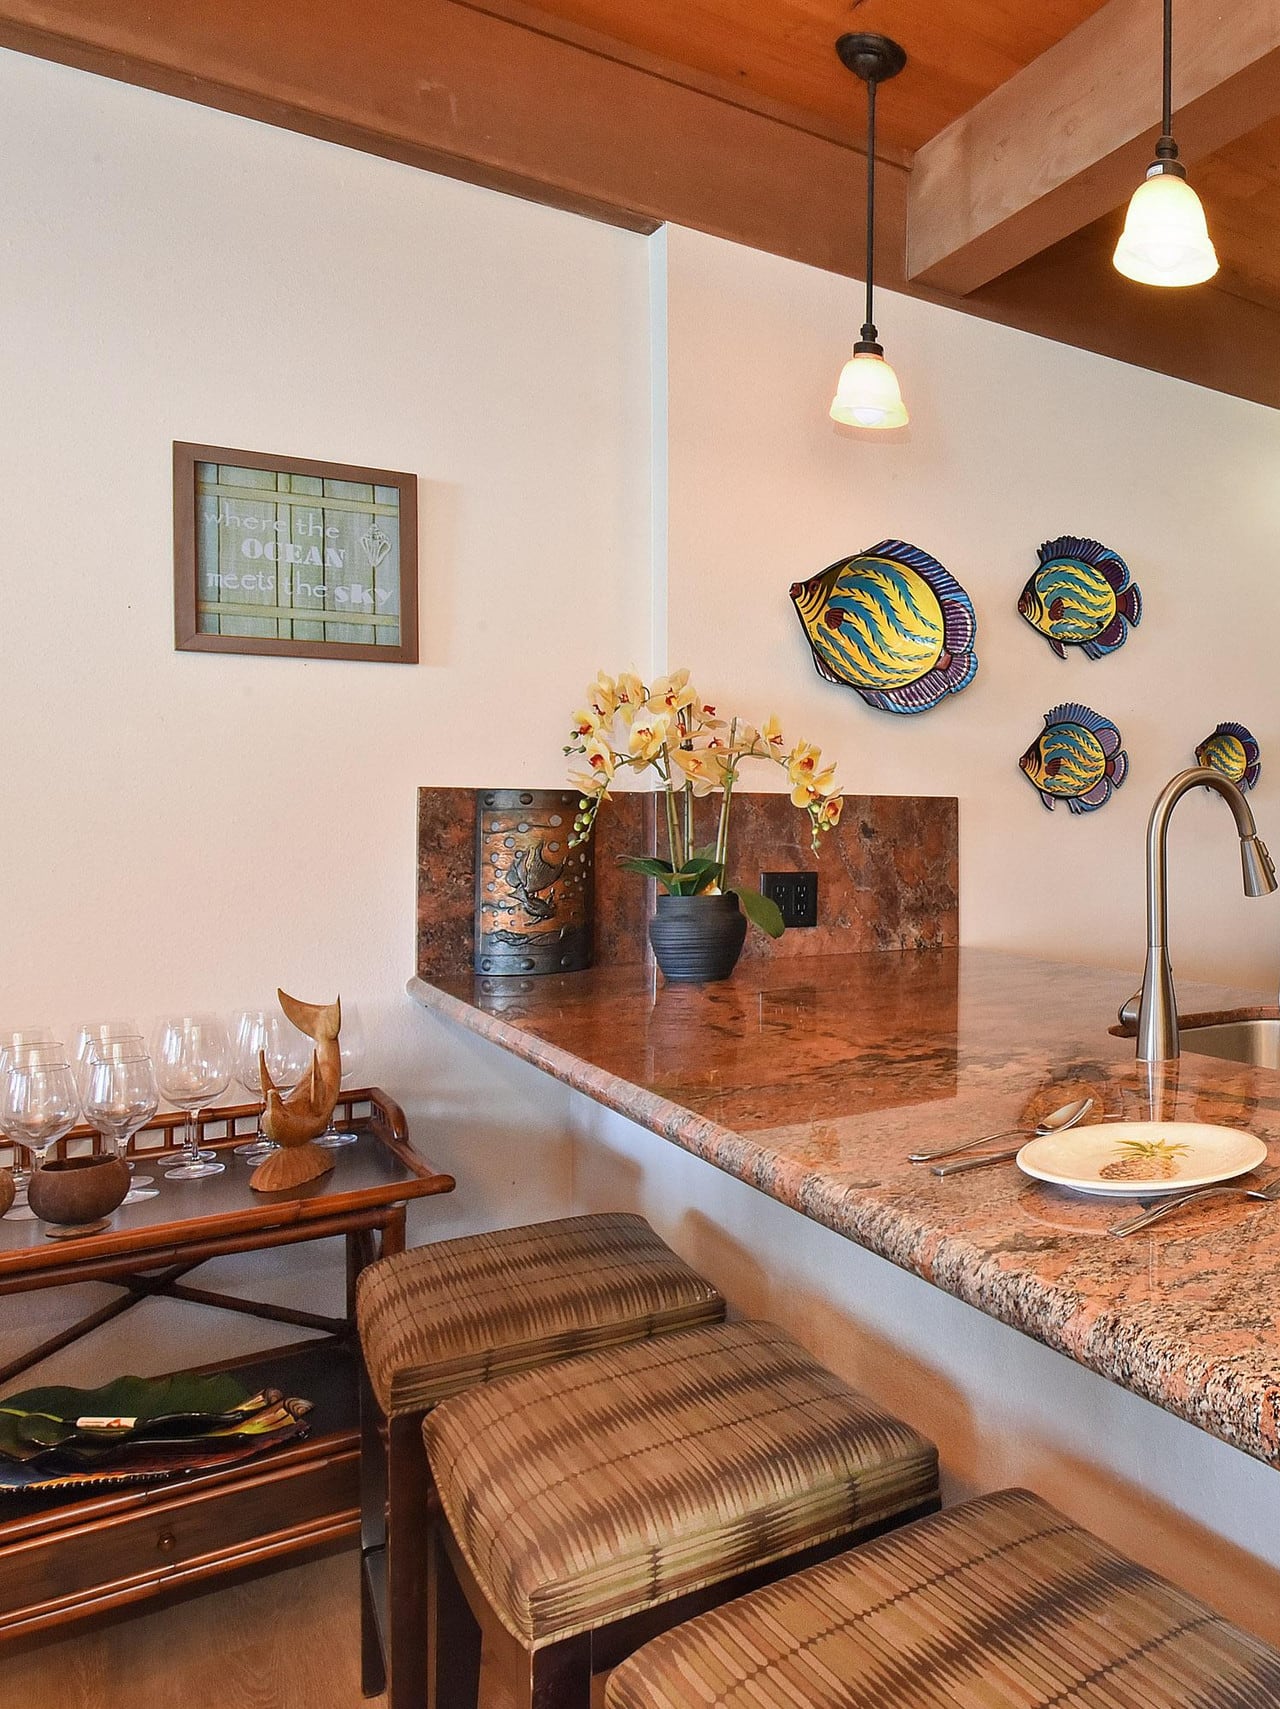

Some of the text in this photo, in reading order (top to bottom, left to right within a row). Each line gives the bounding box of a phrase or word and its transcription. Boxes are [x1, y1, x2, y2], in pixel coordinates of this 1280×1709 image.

[204, 502, 340, 539] where the
[241, 538, 346, 568] OCEAN
[206, 571, 394, 605] meets the sky
